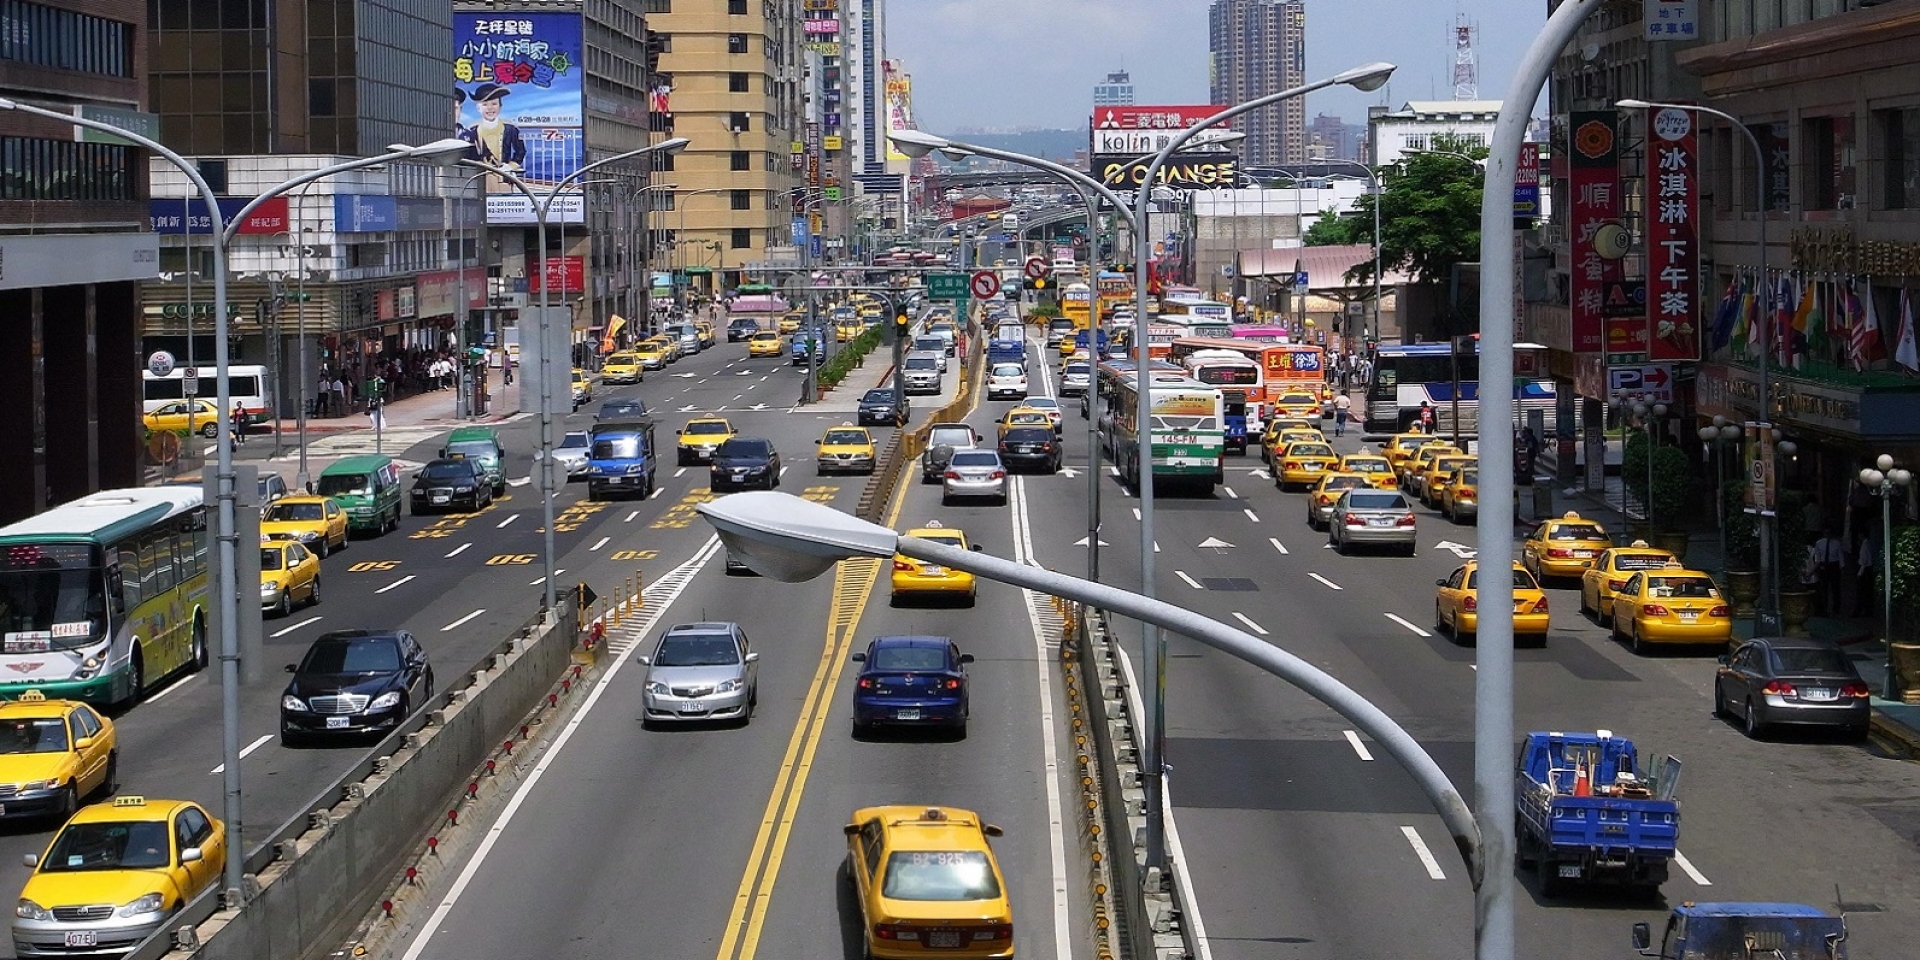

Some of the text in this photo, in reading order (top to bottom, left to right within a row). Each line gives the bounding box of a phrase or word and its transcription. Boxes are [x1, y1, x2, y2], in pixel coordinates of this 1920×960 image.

[1122, 112, 1181, 129] 三菱電機
[1103, 133, 1150, 151] kolin
[1522, 148, 1535, 167] 3F
[1612, 371, 1640, 389] P
[1162, 435, 1197, 444] 145-FM
